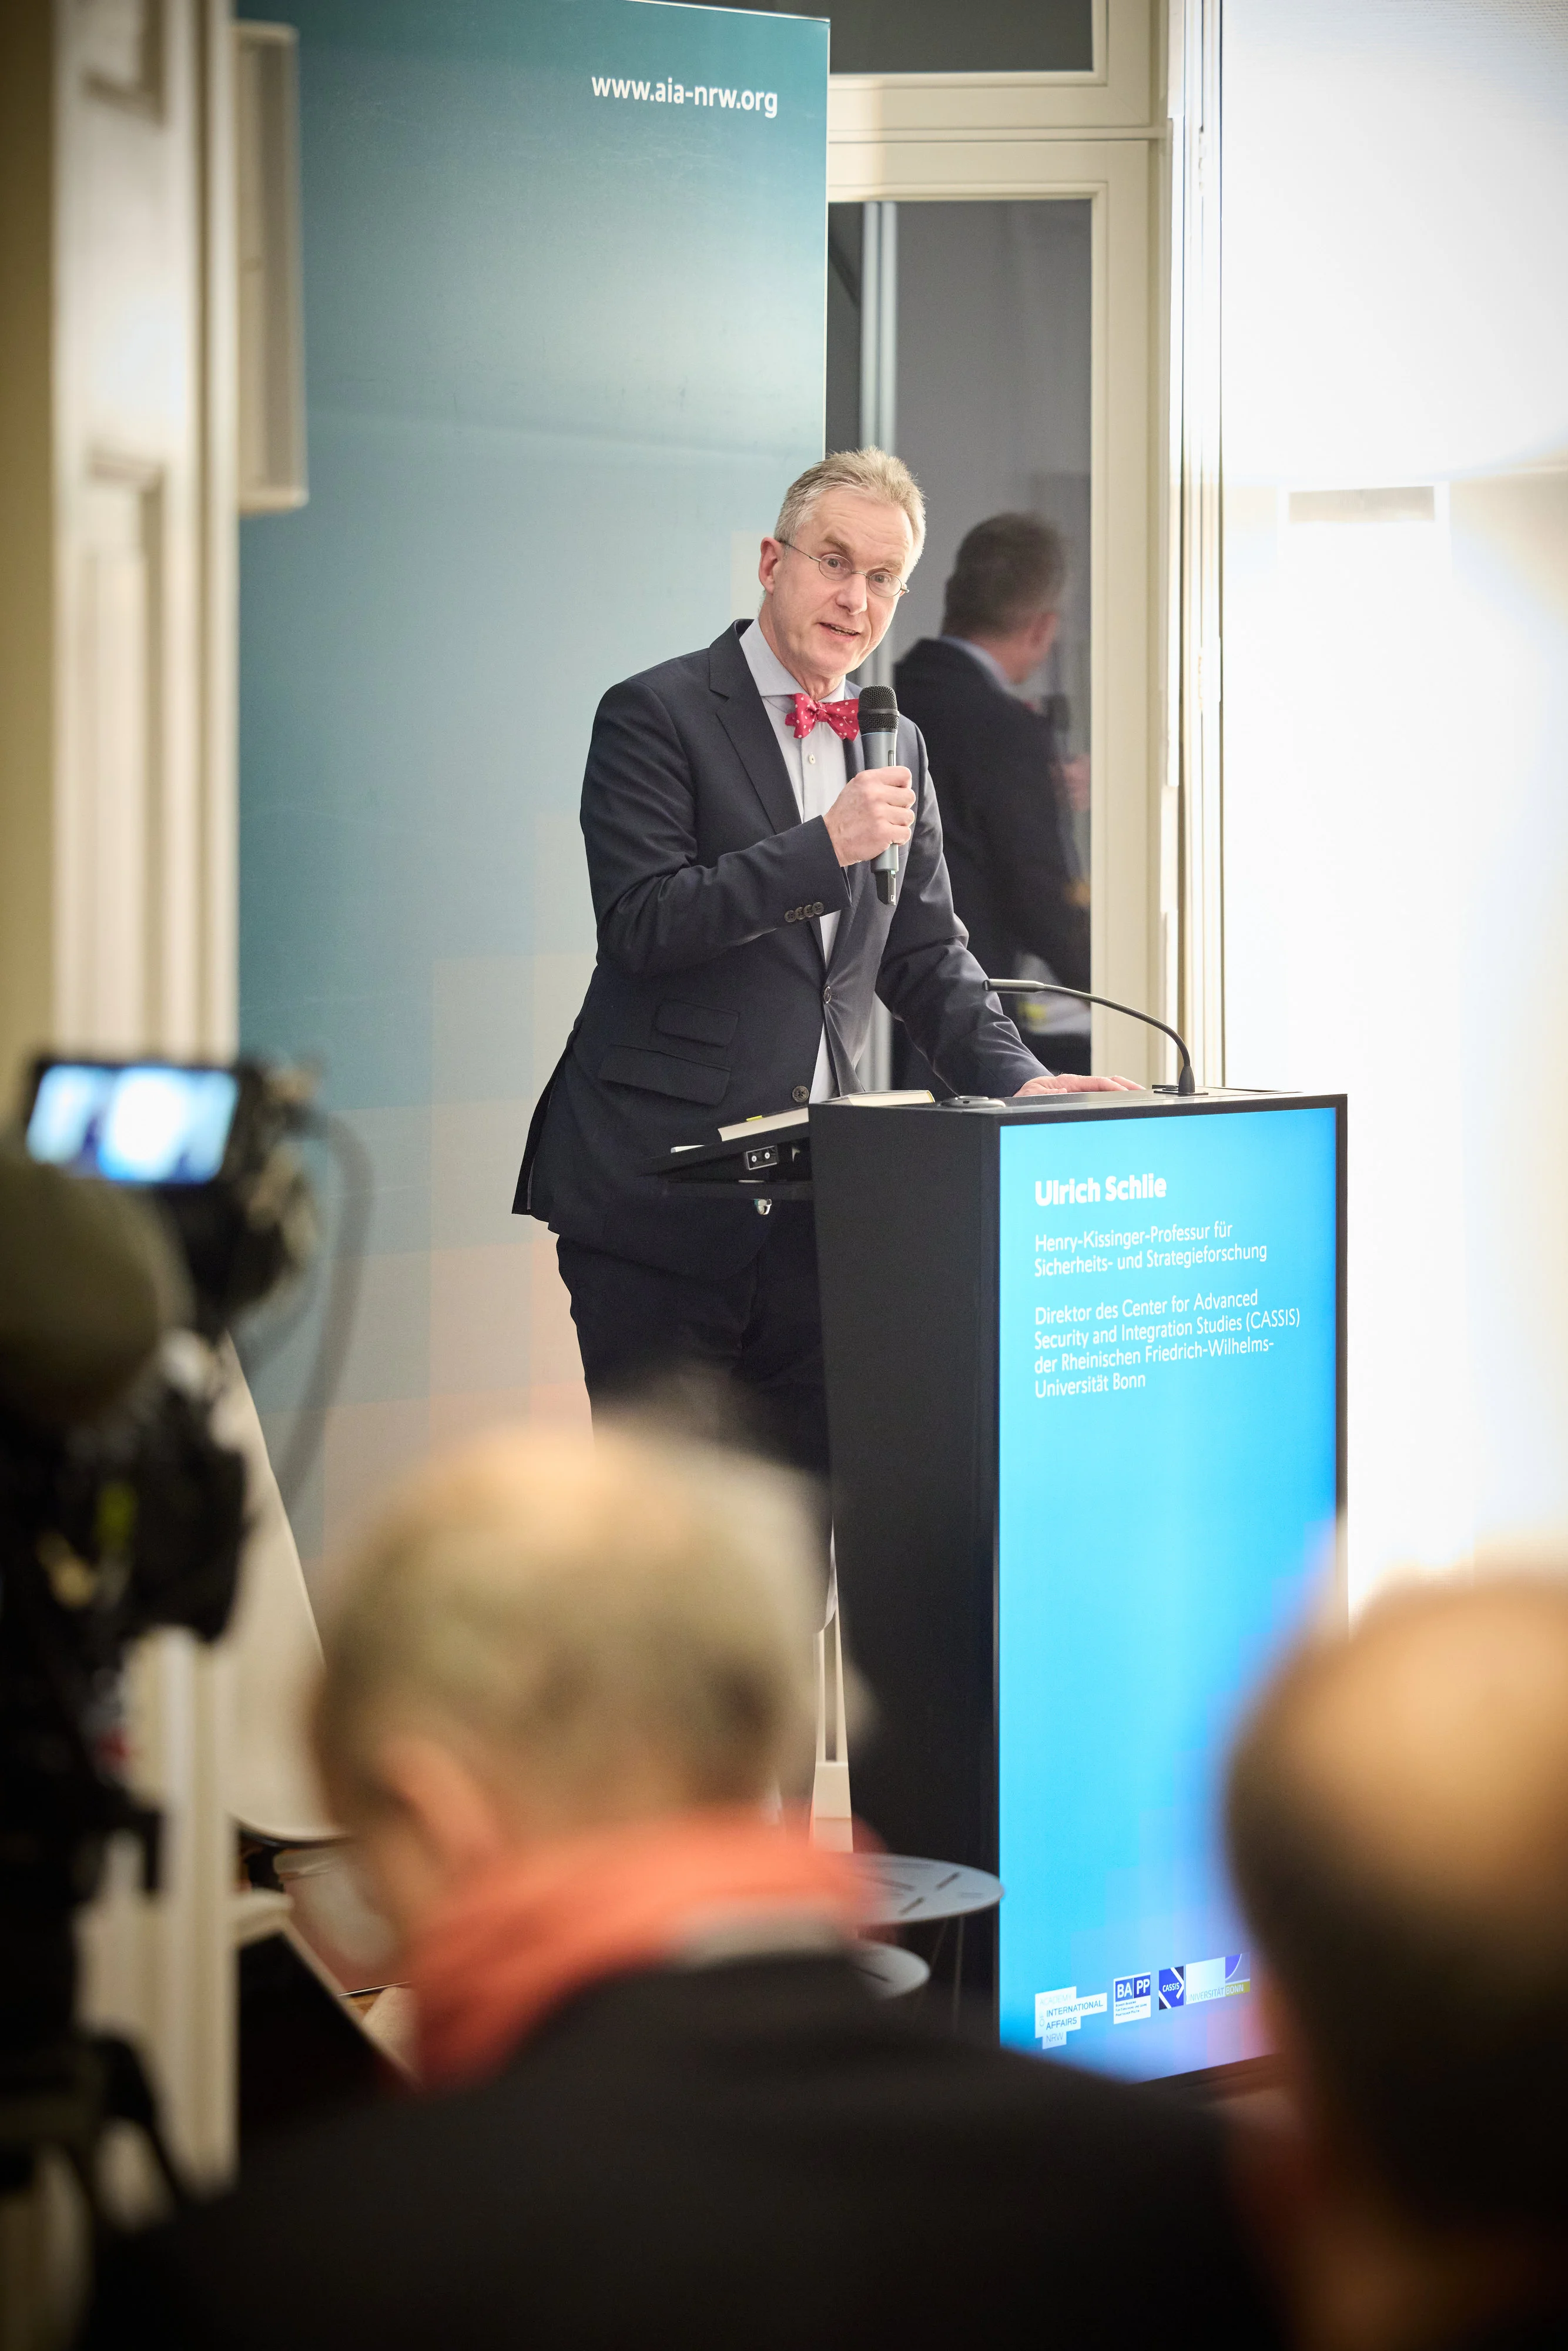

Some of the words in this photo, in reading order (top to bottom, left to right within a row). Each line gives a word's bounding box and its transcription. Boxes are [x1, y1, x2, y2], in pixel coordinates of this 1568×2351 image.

[592, 76, 778, 118] www.aia-nrw.org
[1035, 1178, 1100, 1206] Ulrich
[1105, 1173, 1167, 1201] Schlie
[1036, 1224, 1211, 1252] Henry-Kissinger-Professur
[1214, 1221, 1232, 1237] für
[1034, 1254, 1113, 1277] Sicherheits-
[1117, 1251, 1142, 1270] und
[1147, 1244, 1267, 1269] Strategieforschung
[1036, 1306, 1091, 1325] Direktor
[1095, 1302, 1118, 1319] des
[1122, 1298, 1167, 1317] Center
[1171, 1295, 1190, 1312] for
[1194, 1289, 1258, 1311] Advanced
[1034, 1326, 1089, 1350] Security
[1093, 1324, 1117, 1344] and
[1122, 1316, 1192, 1344] Integration
[1197, 1312, 1242, 1334] Studies
[1246, 1308, 1300, 1332] (CASSIS)
[1034, 1357, 1057, 1374] der
[1062, 1348, 1141, 1371] Rheinischen
[1145, 1337, 1274, 1363] Friedrich-Wilhelms-
[1036, 1376, 1109, 1398] Universität
[1113, 1372, 1146, 1390] Bonn
[1117, 1982, 1133, 1998] BA
[1137, 1978, 1150, 1995] PP
[1162, 1982, 1180, 1992] CASSIS
[1226, 1984, 1244, 1995] BONN
[1047, 2001, 1103, 2017] INTERNATIONAL
[1046, 2017, 1077, 2030] AFFAIRS
[1046, 2033, 1064, 2043] NRW
